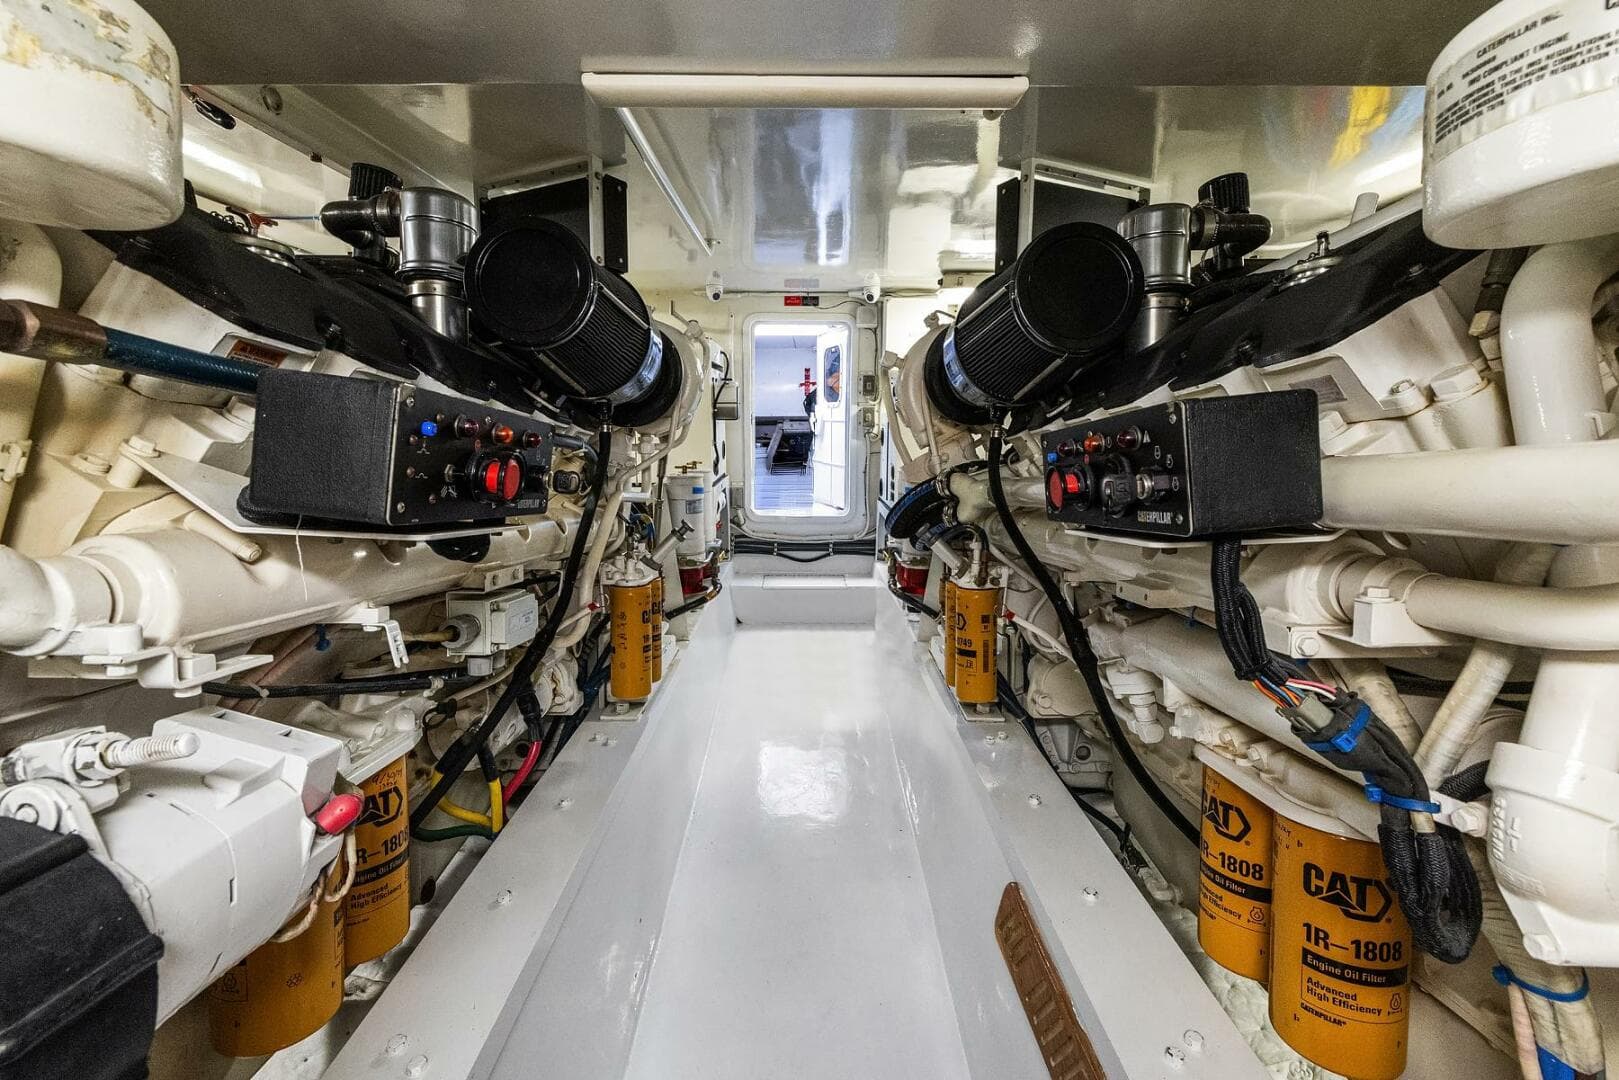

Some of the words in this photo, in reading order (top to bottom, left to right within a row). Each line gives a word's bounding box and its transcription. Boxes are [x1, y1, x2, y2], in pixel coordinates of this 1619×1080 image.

[1138, 511, 1173, 524] CATERPILLAR
[1302, 861, 1376, 913] CAT
[1306, 954, 1342, 979] Engine
[1344, 965, 1359, 979] Oil
[1360, 968, 1387, 984] Filter
[1306, 977, 1357, 1001] Advanced
[1306, 985, 1329, 1003] High
[1332, 997, 1383, 1016] Efficiency
